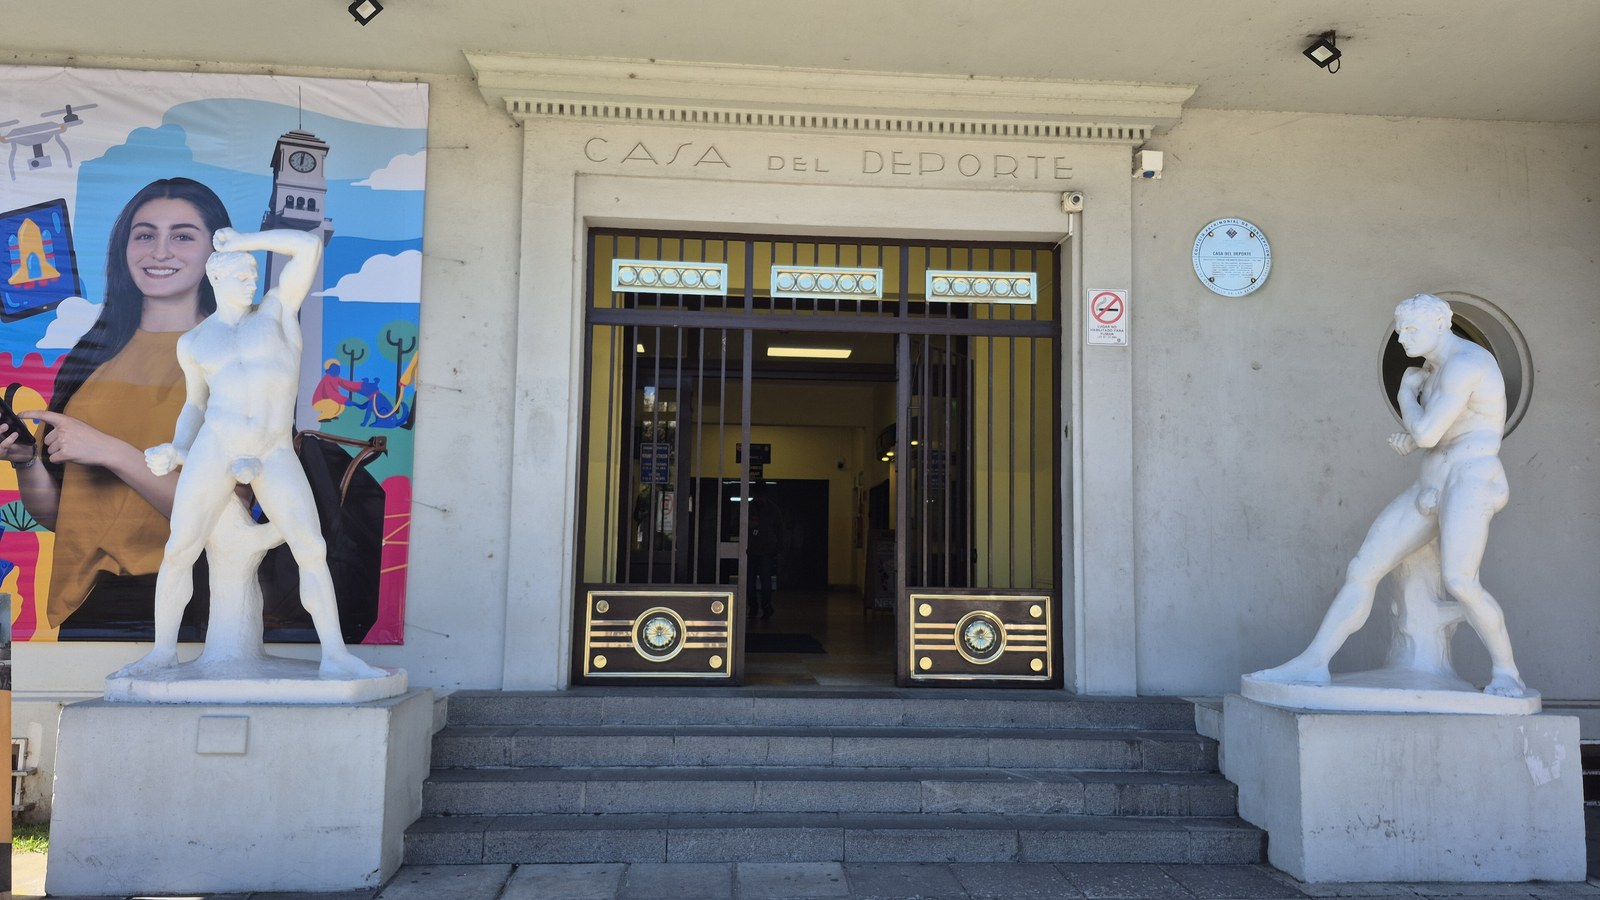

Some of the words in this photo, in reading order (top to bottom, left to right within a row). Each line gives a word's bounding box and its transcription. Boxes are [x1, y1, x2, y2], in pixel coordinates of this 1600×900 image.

[583, 137, 732, 168] CASA
[767, 155, 829, 173] DEL
[862, 149, 1074, 180] DEPORTE
